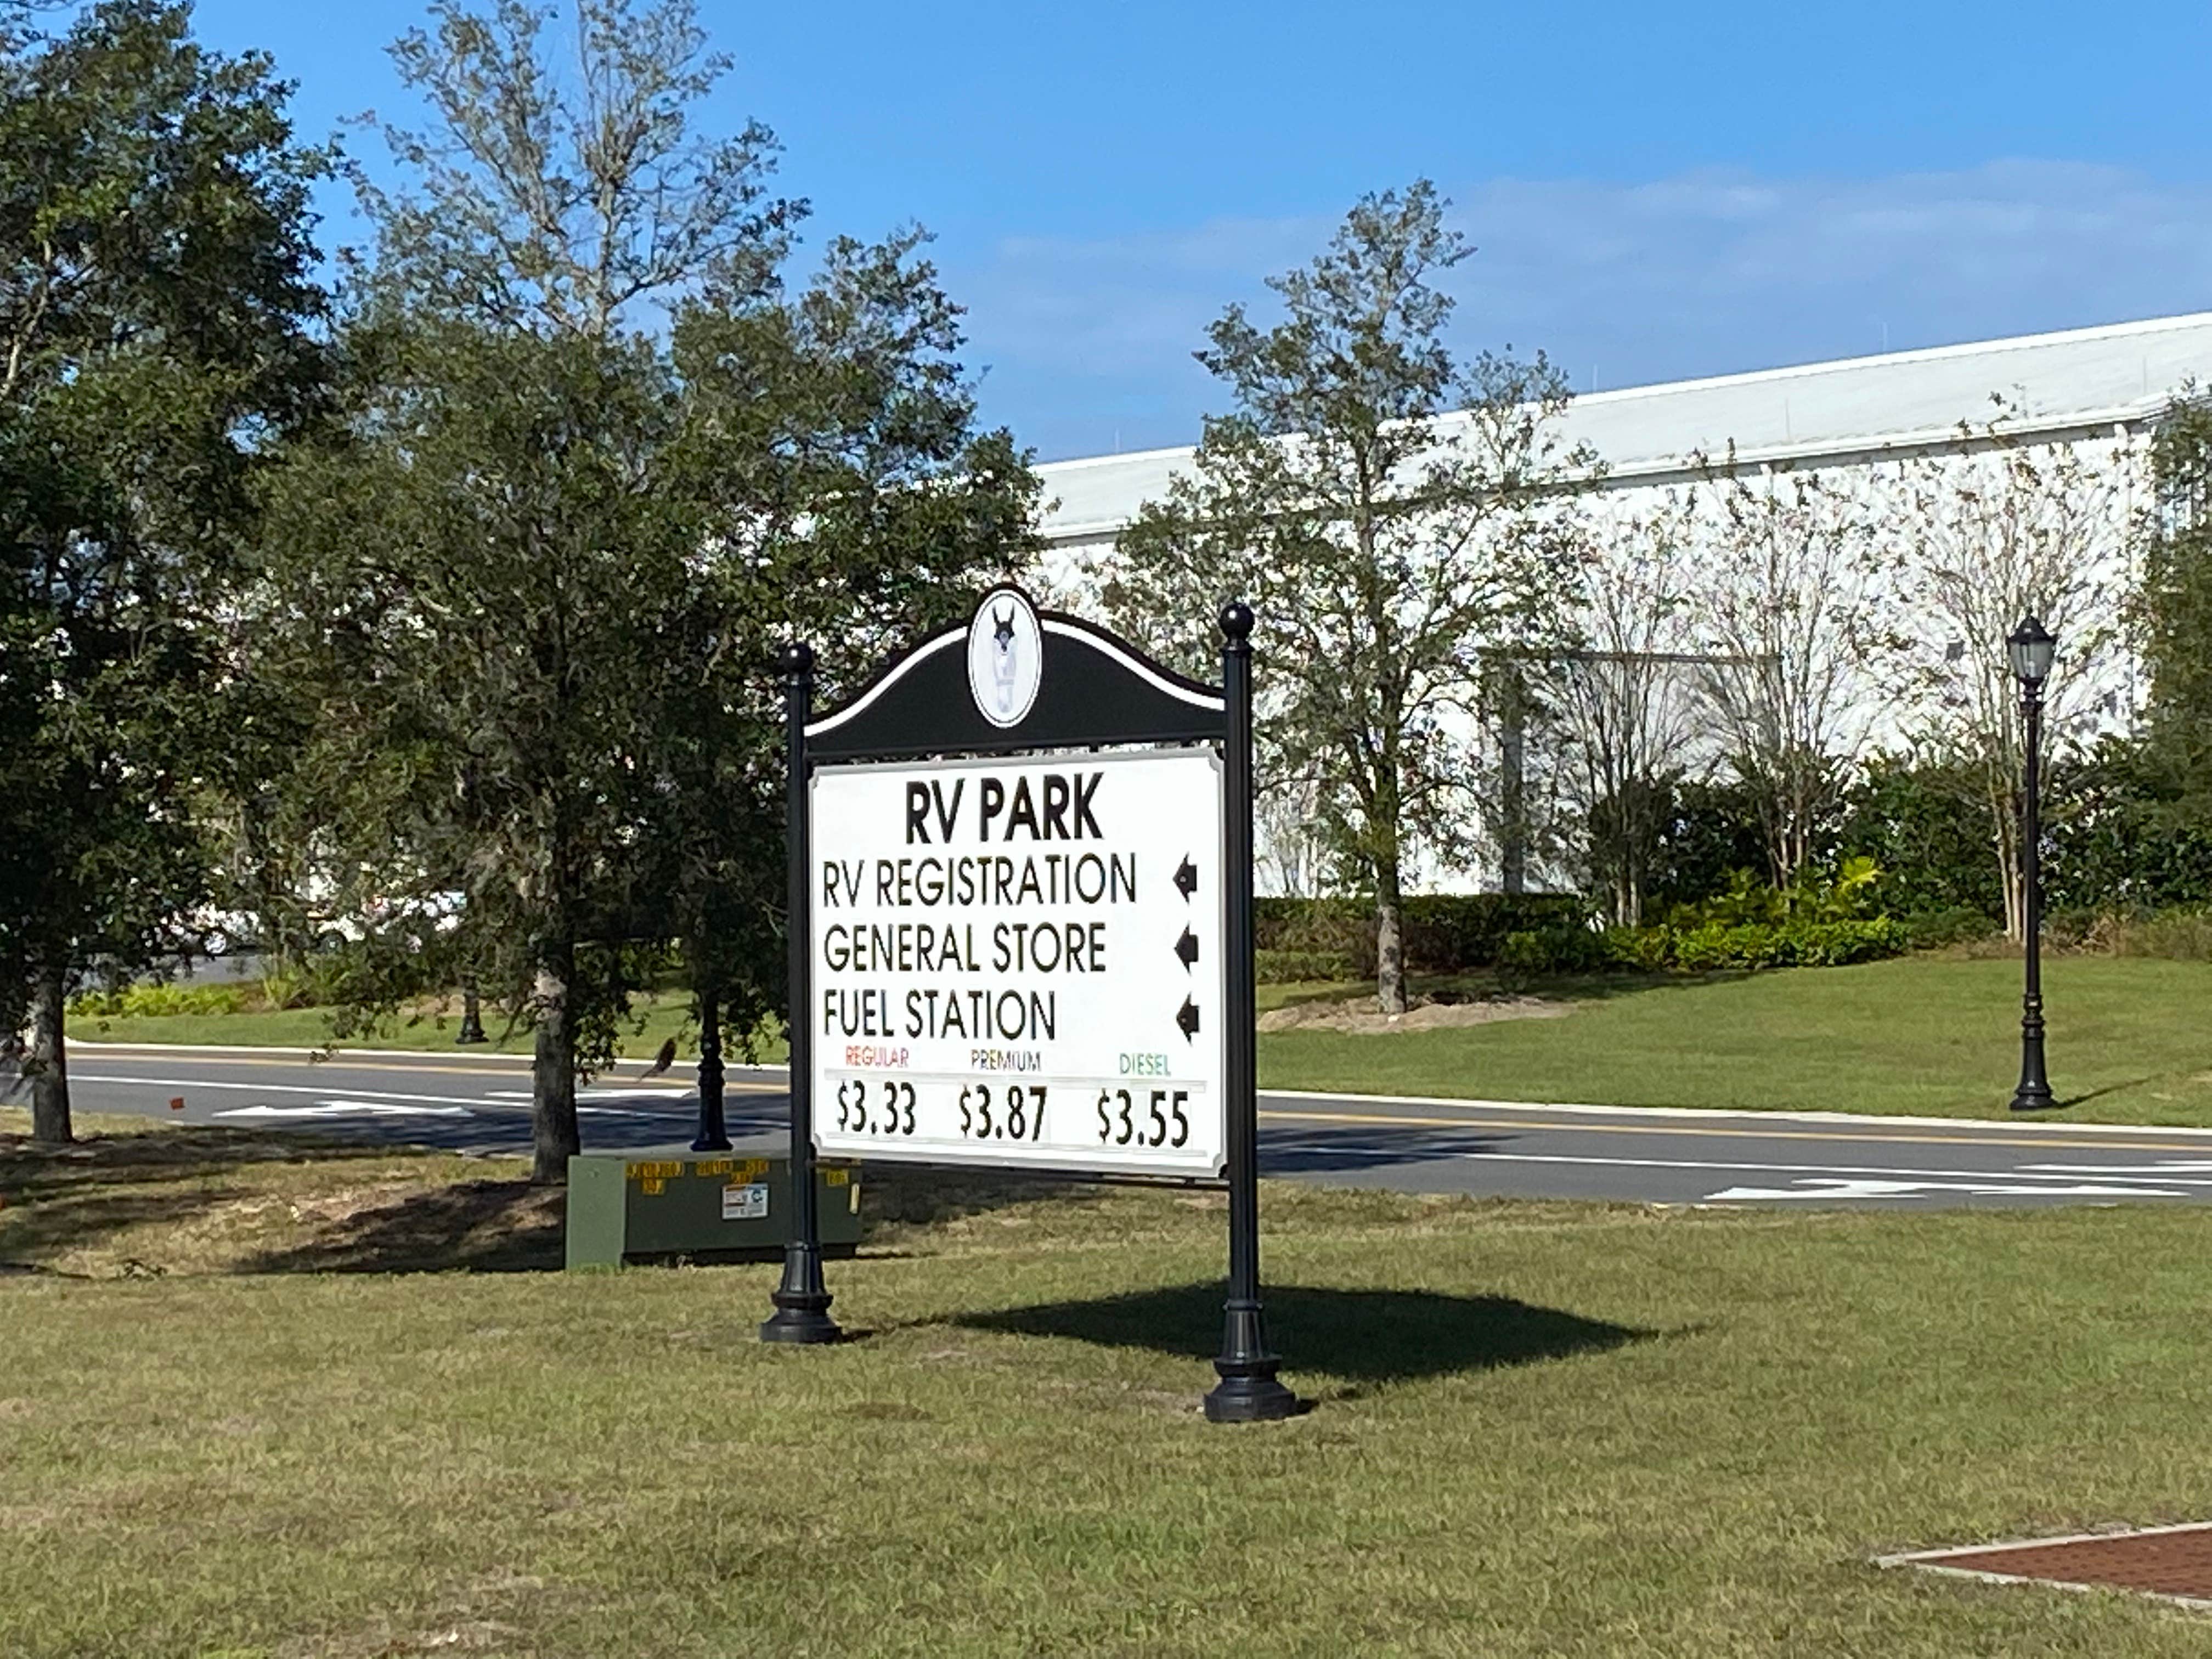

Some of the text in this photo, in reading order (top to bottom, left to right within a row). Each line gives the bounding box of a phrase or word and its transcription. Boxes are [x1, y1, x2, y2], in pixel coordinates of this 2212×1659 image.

[905, 771, 1104, 845] RV PARK
[823, 851, 1136, 908] RV REGISTRATION
[823, 921, 1107, 974] GENERAL STORE
[824, 988, 1056, 1041] FUEL STATION
[845, 1045, 910, 1068] REGULAR
[970, 1048, 1041, 1073] PREMIUM
[1119, 1052, 1172, 1077] DIESEL
[837, 1079, 917, 1136] $3.33
[958, 1083, 1048, 1142] $3.87
[1097, 1087, 1189, 1149] $3.55
